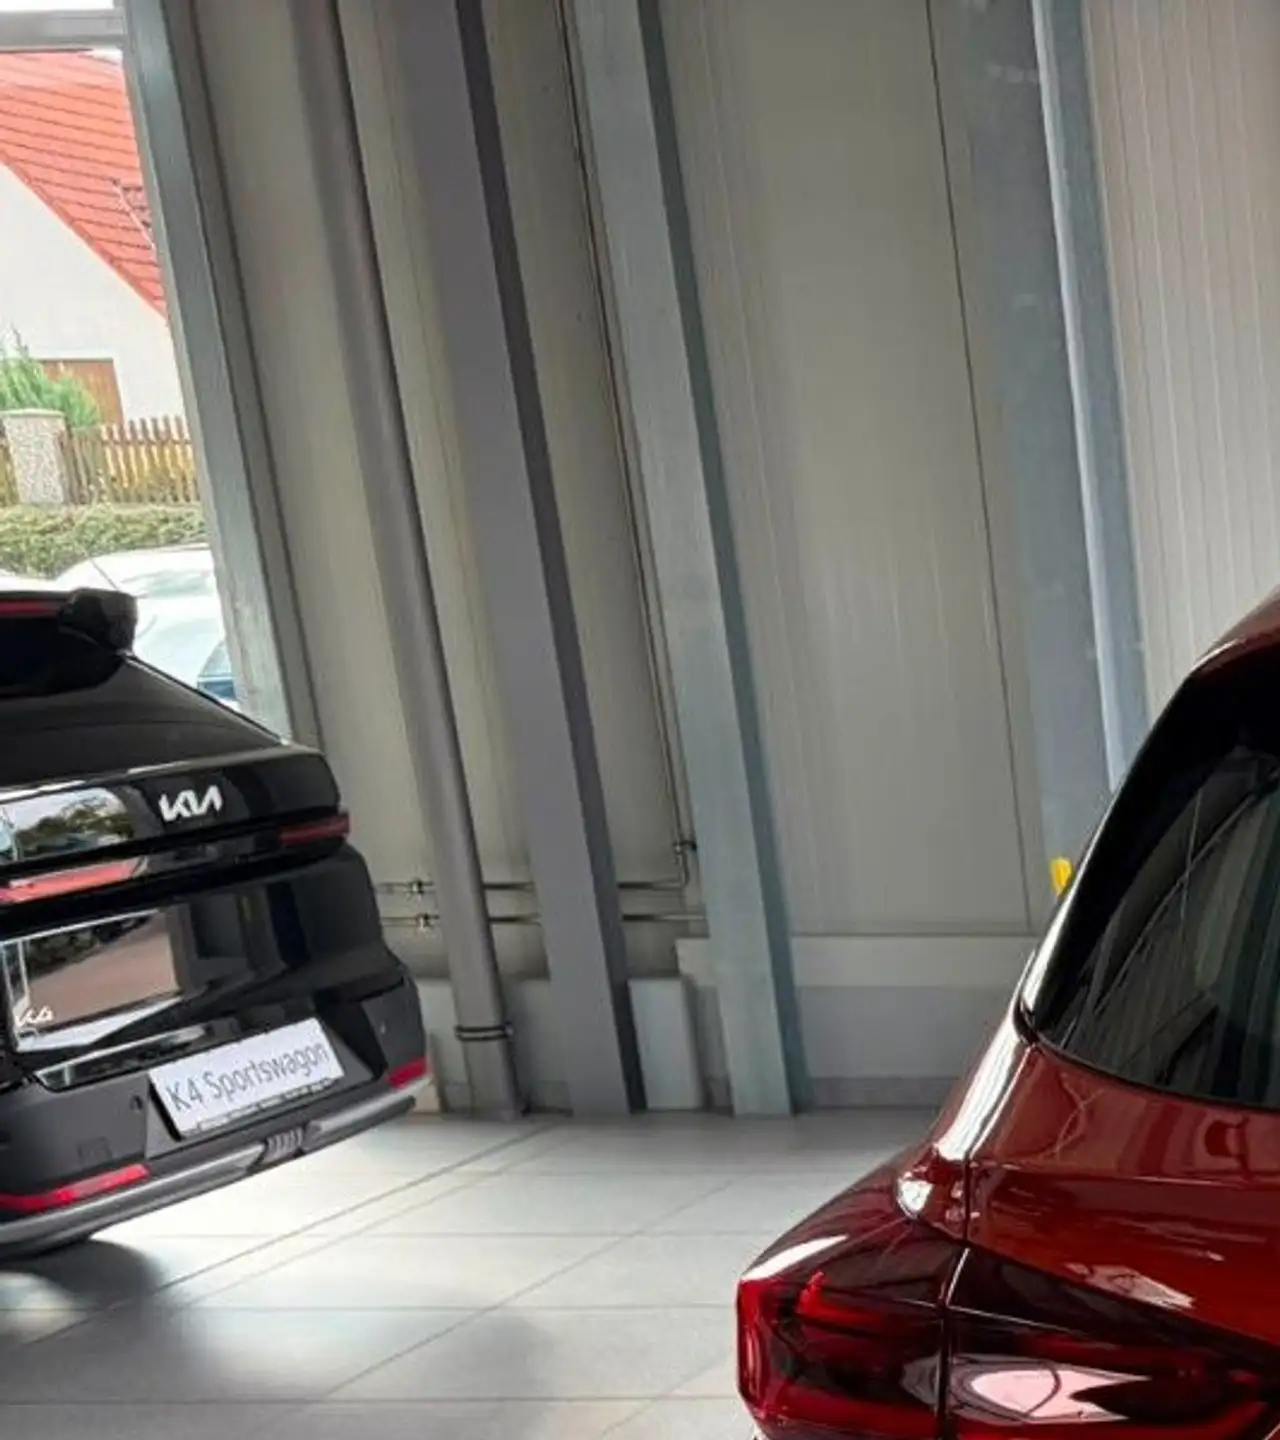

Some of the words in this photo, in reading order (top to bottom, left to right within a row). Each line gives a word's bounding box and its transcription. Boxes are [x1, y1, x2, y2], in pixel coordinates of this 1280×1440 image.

[158, 784, 222, 822] KIA
[165, 1078, 203, 1111] K4
[203, 1043, 329, 1101] Sportswagon
